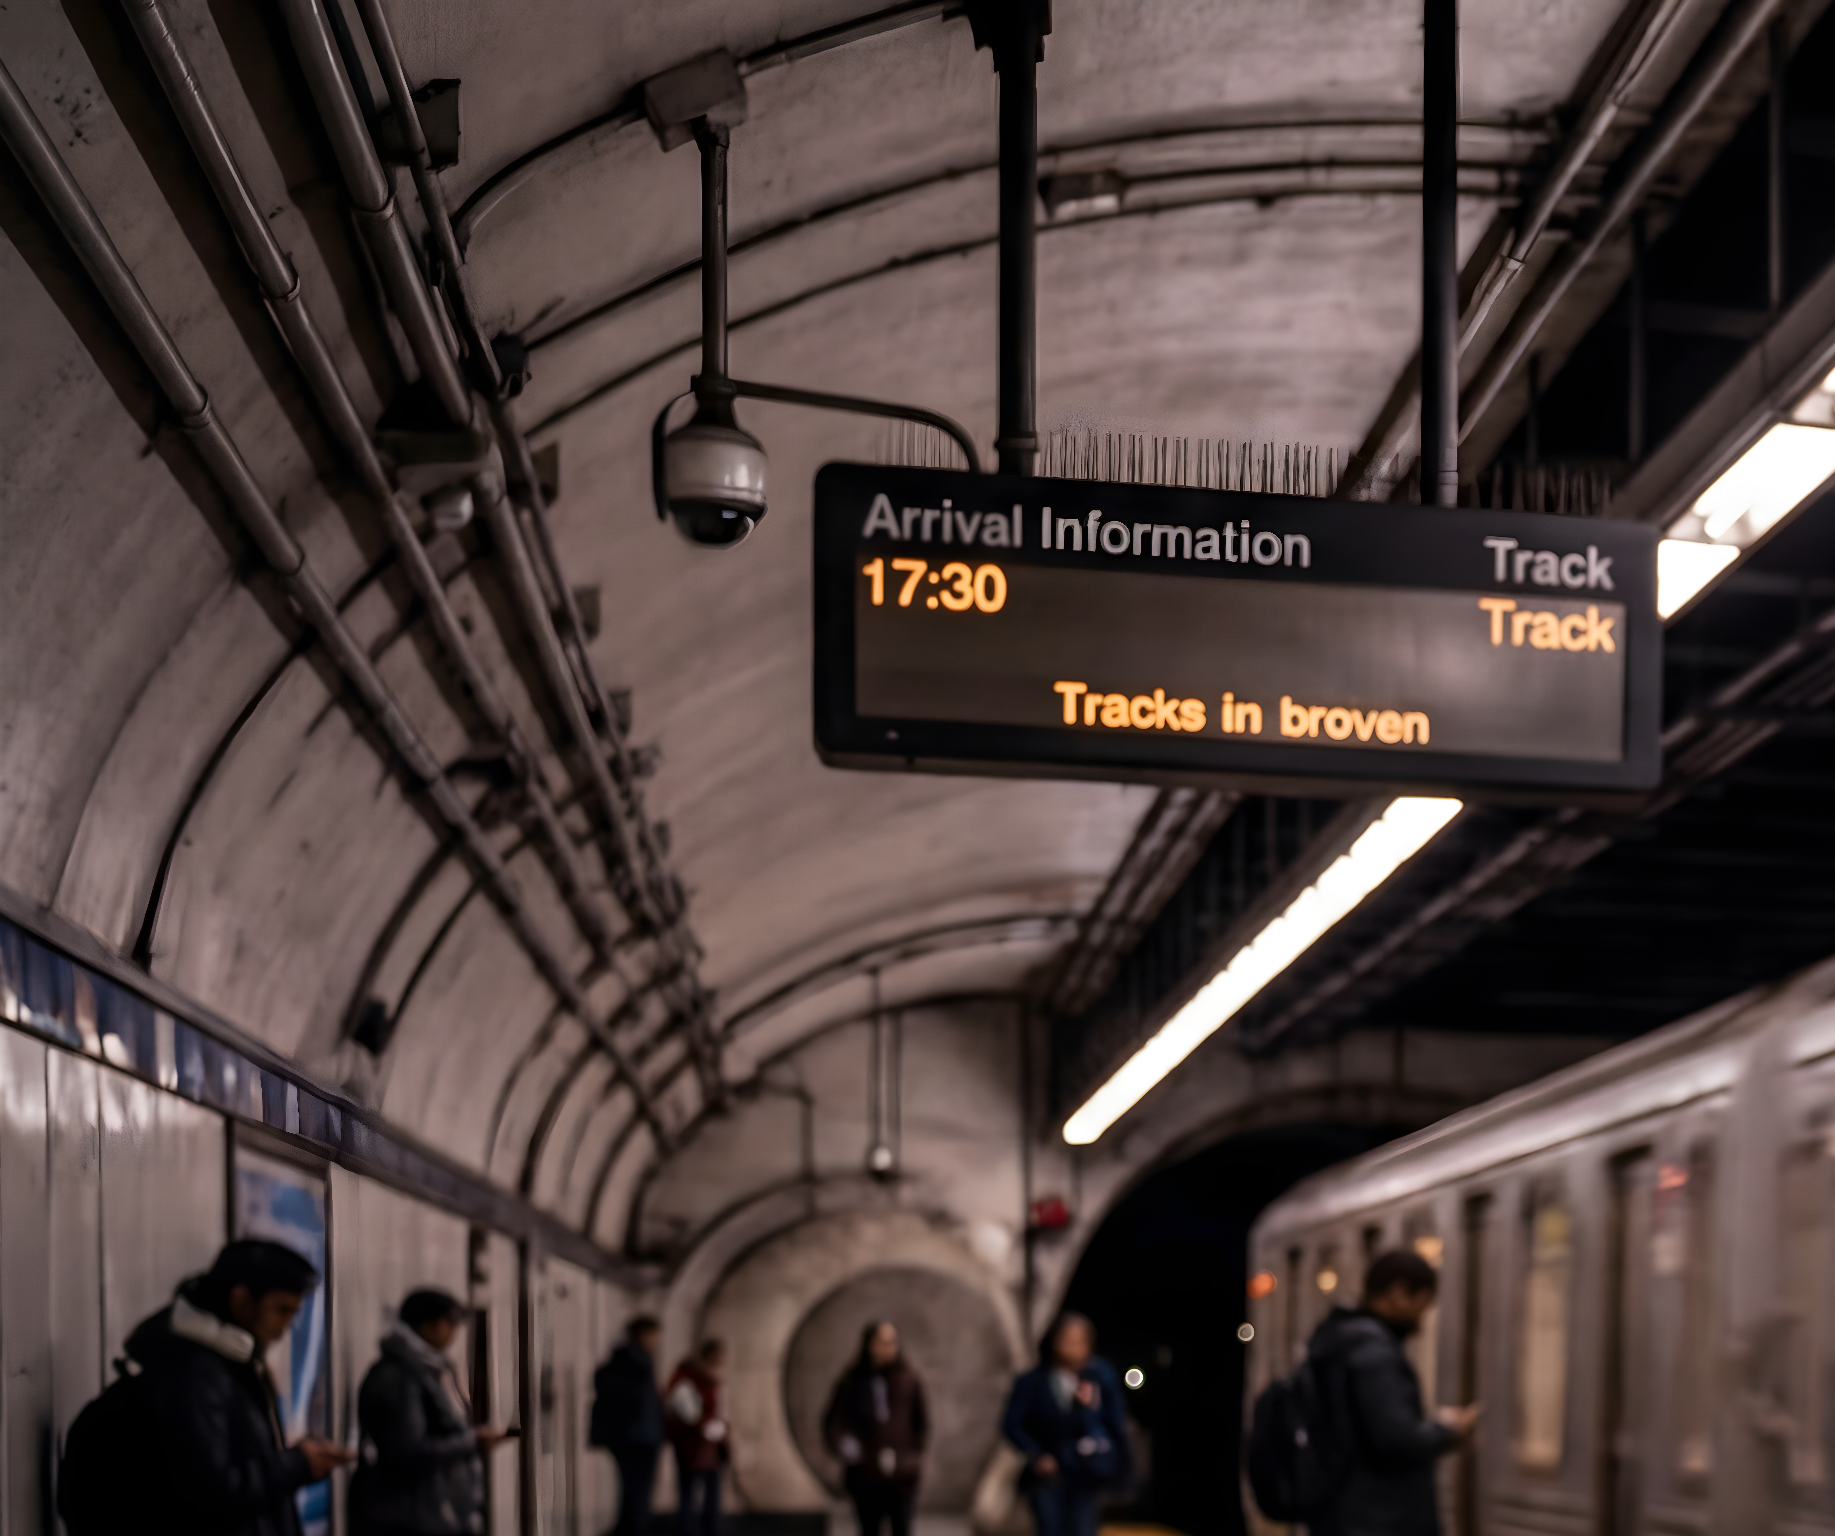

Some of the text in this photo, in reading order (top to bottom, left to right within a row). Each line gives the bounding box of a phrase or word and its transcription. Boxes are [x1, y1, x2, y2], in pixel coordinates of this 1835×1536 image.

[863, 493, 1311, 568] Arrival Information
[862, 558, 1008, 613] 17:30
[1484, 536, 1615, 590] Track
[1478, 597, 1616, 654] Track
[1053, 681, 1431, 745] Tracks in broven
